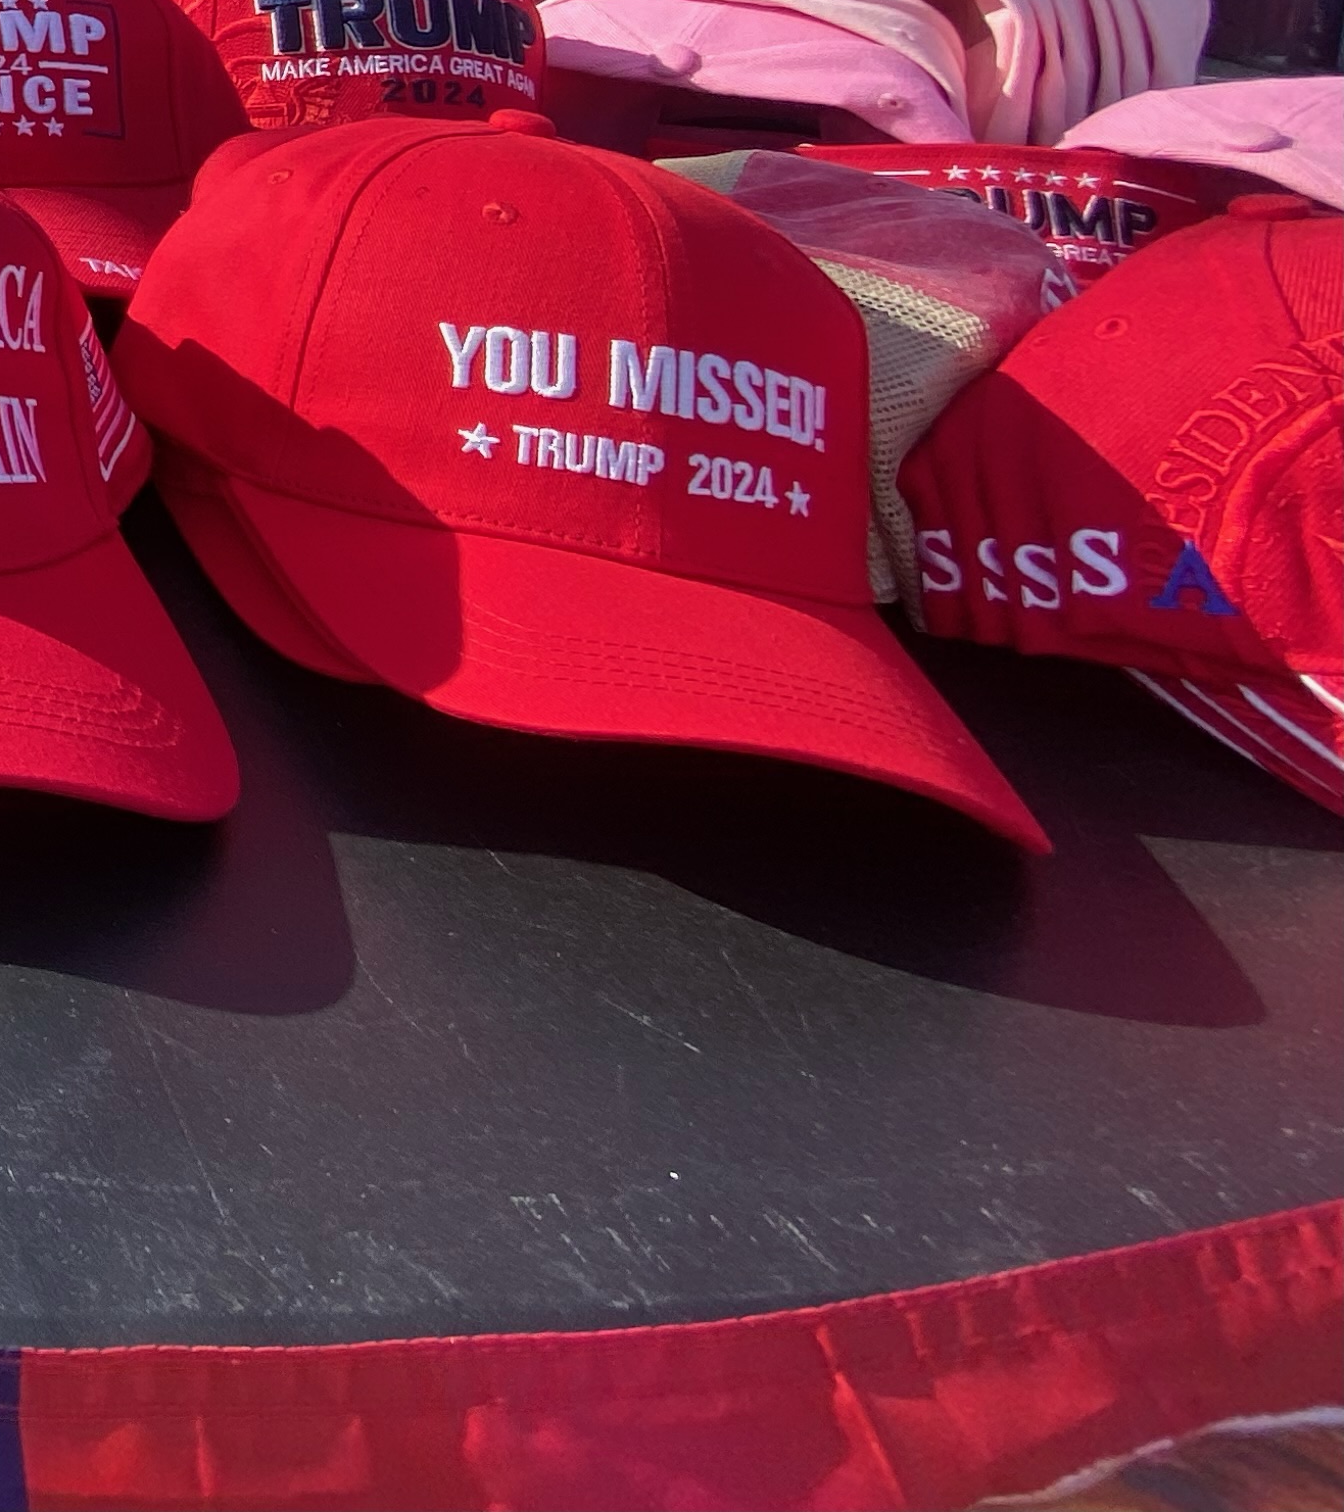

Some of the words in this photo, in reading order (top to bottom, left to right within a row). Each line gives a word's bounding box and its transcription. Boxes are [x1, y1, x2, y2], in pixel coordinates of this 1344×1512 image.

[262, 57, 330, 82] MAKE
[337, 54, 445, 76] AMERICA
[449, 59, 504, 86] GREAT
[380, 78, 486, 108] 2024
[952, 185, 1159, 248] UMP
[439, 321, 576, 399] YOU
[608, 339, 827, 453] MISSED!
[512, 423, 664, 487] TRUMP
[687, 452, 779, 509] 2024
